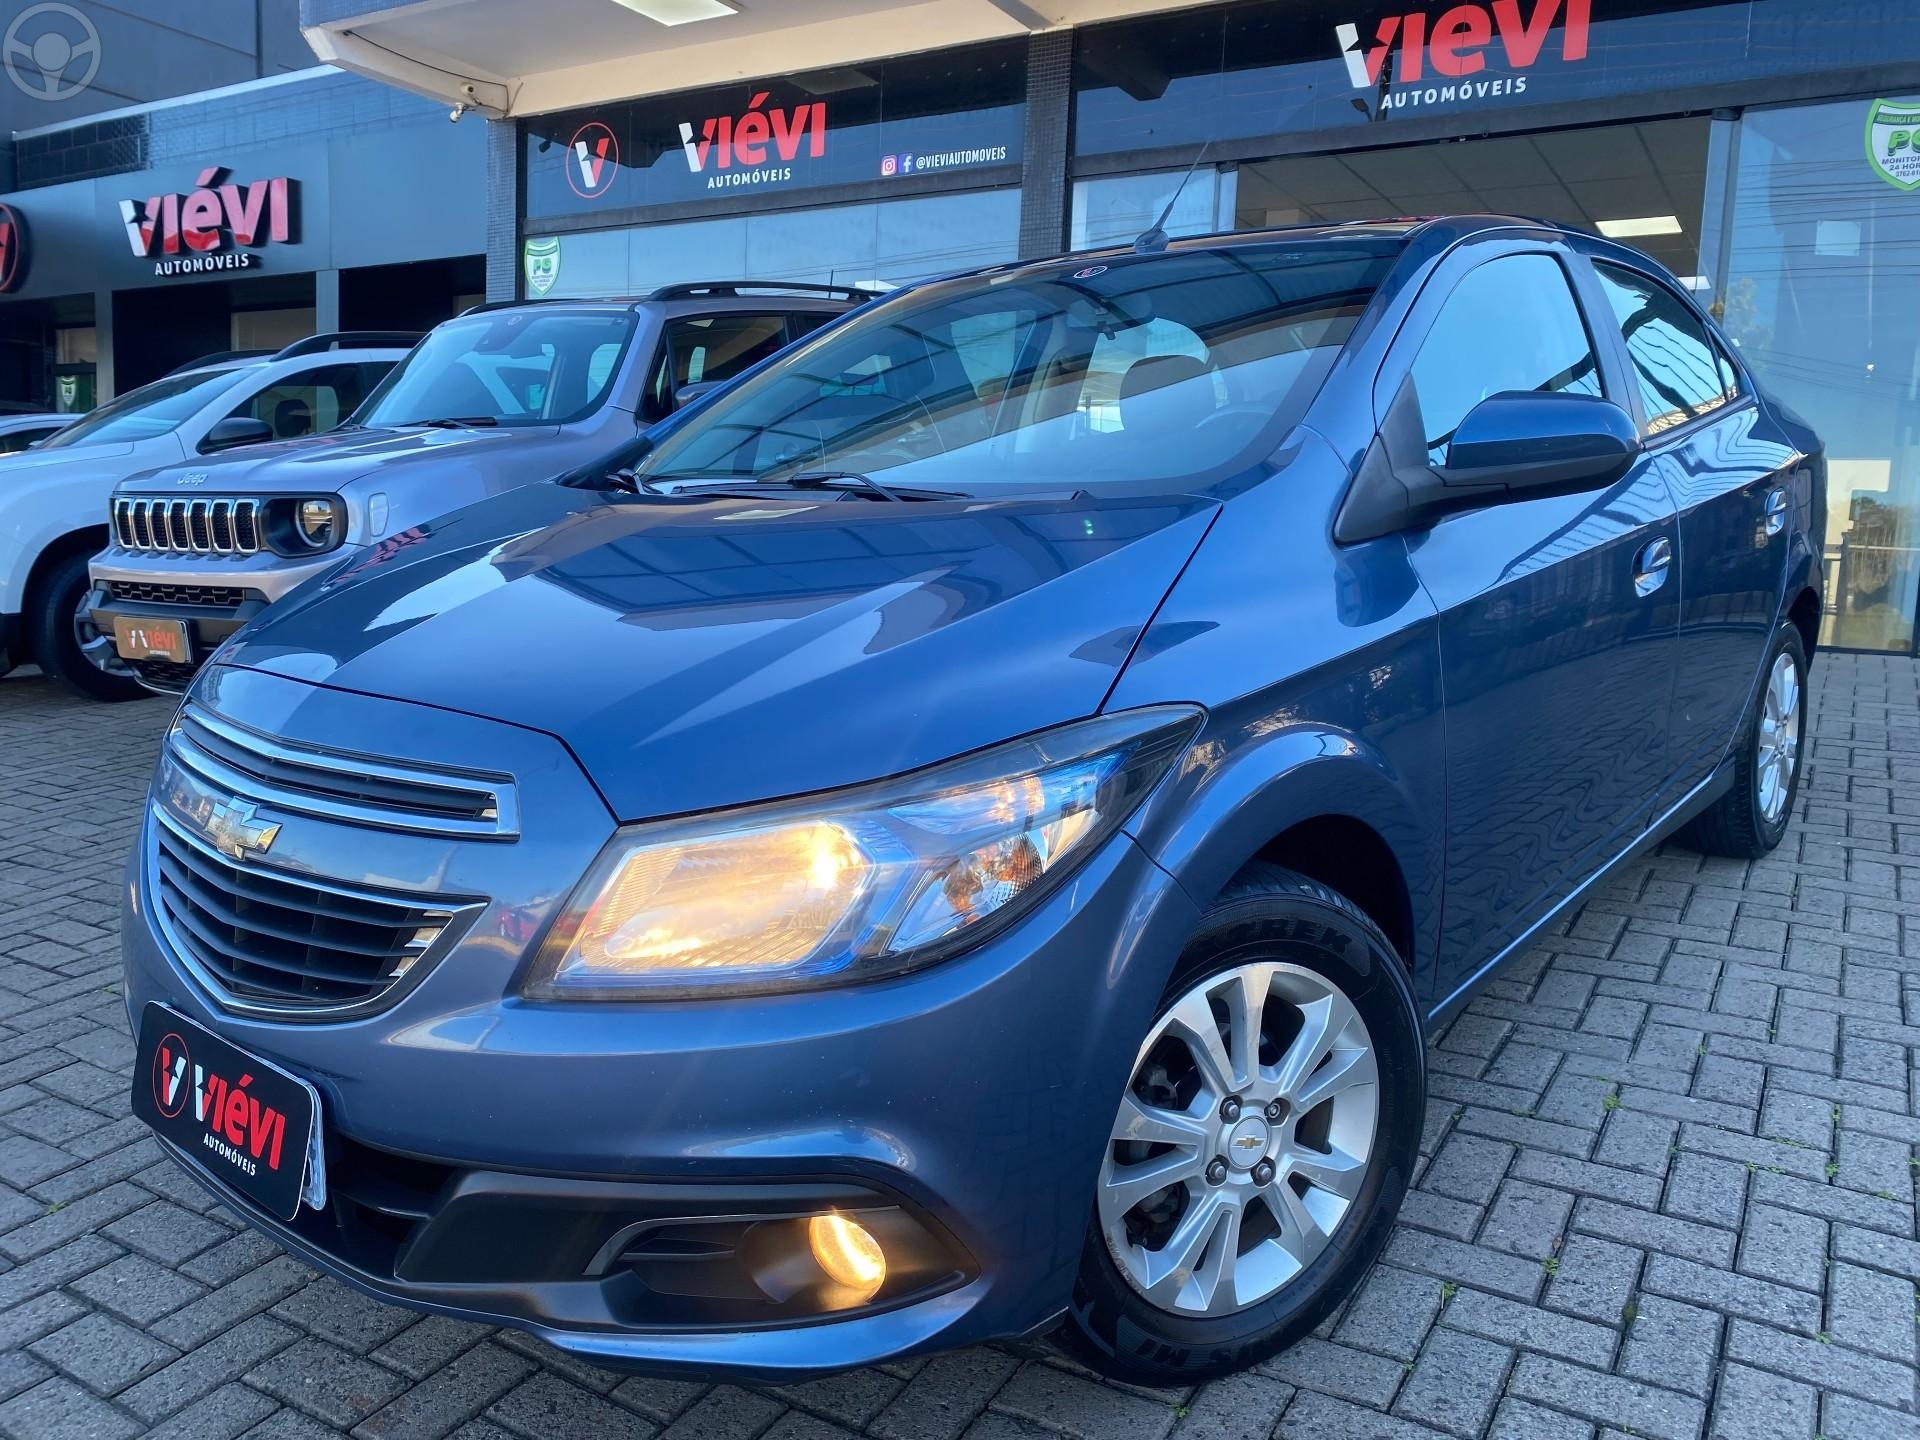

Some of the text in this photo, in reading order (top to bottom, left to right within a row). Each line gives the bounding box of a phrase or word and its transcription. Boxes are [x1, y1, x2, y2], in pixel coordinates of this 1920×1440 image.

[1381, 76, 1528, 110] AUTOMÓVEIS
[915, 146, 1006, 169] @VIEVIAUTOMOVEIS
[707, 167, 792, 189] AUTOMÓVEIS
[154, 252, 250, 276] AUTOMÓVEIS
[177, 472, 208, 486] Jeep
[203, 1132, 257, 1177] AUTOMÓVEIS
